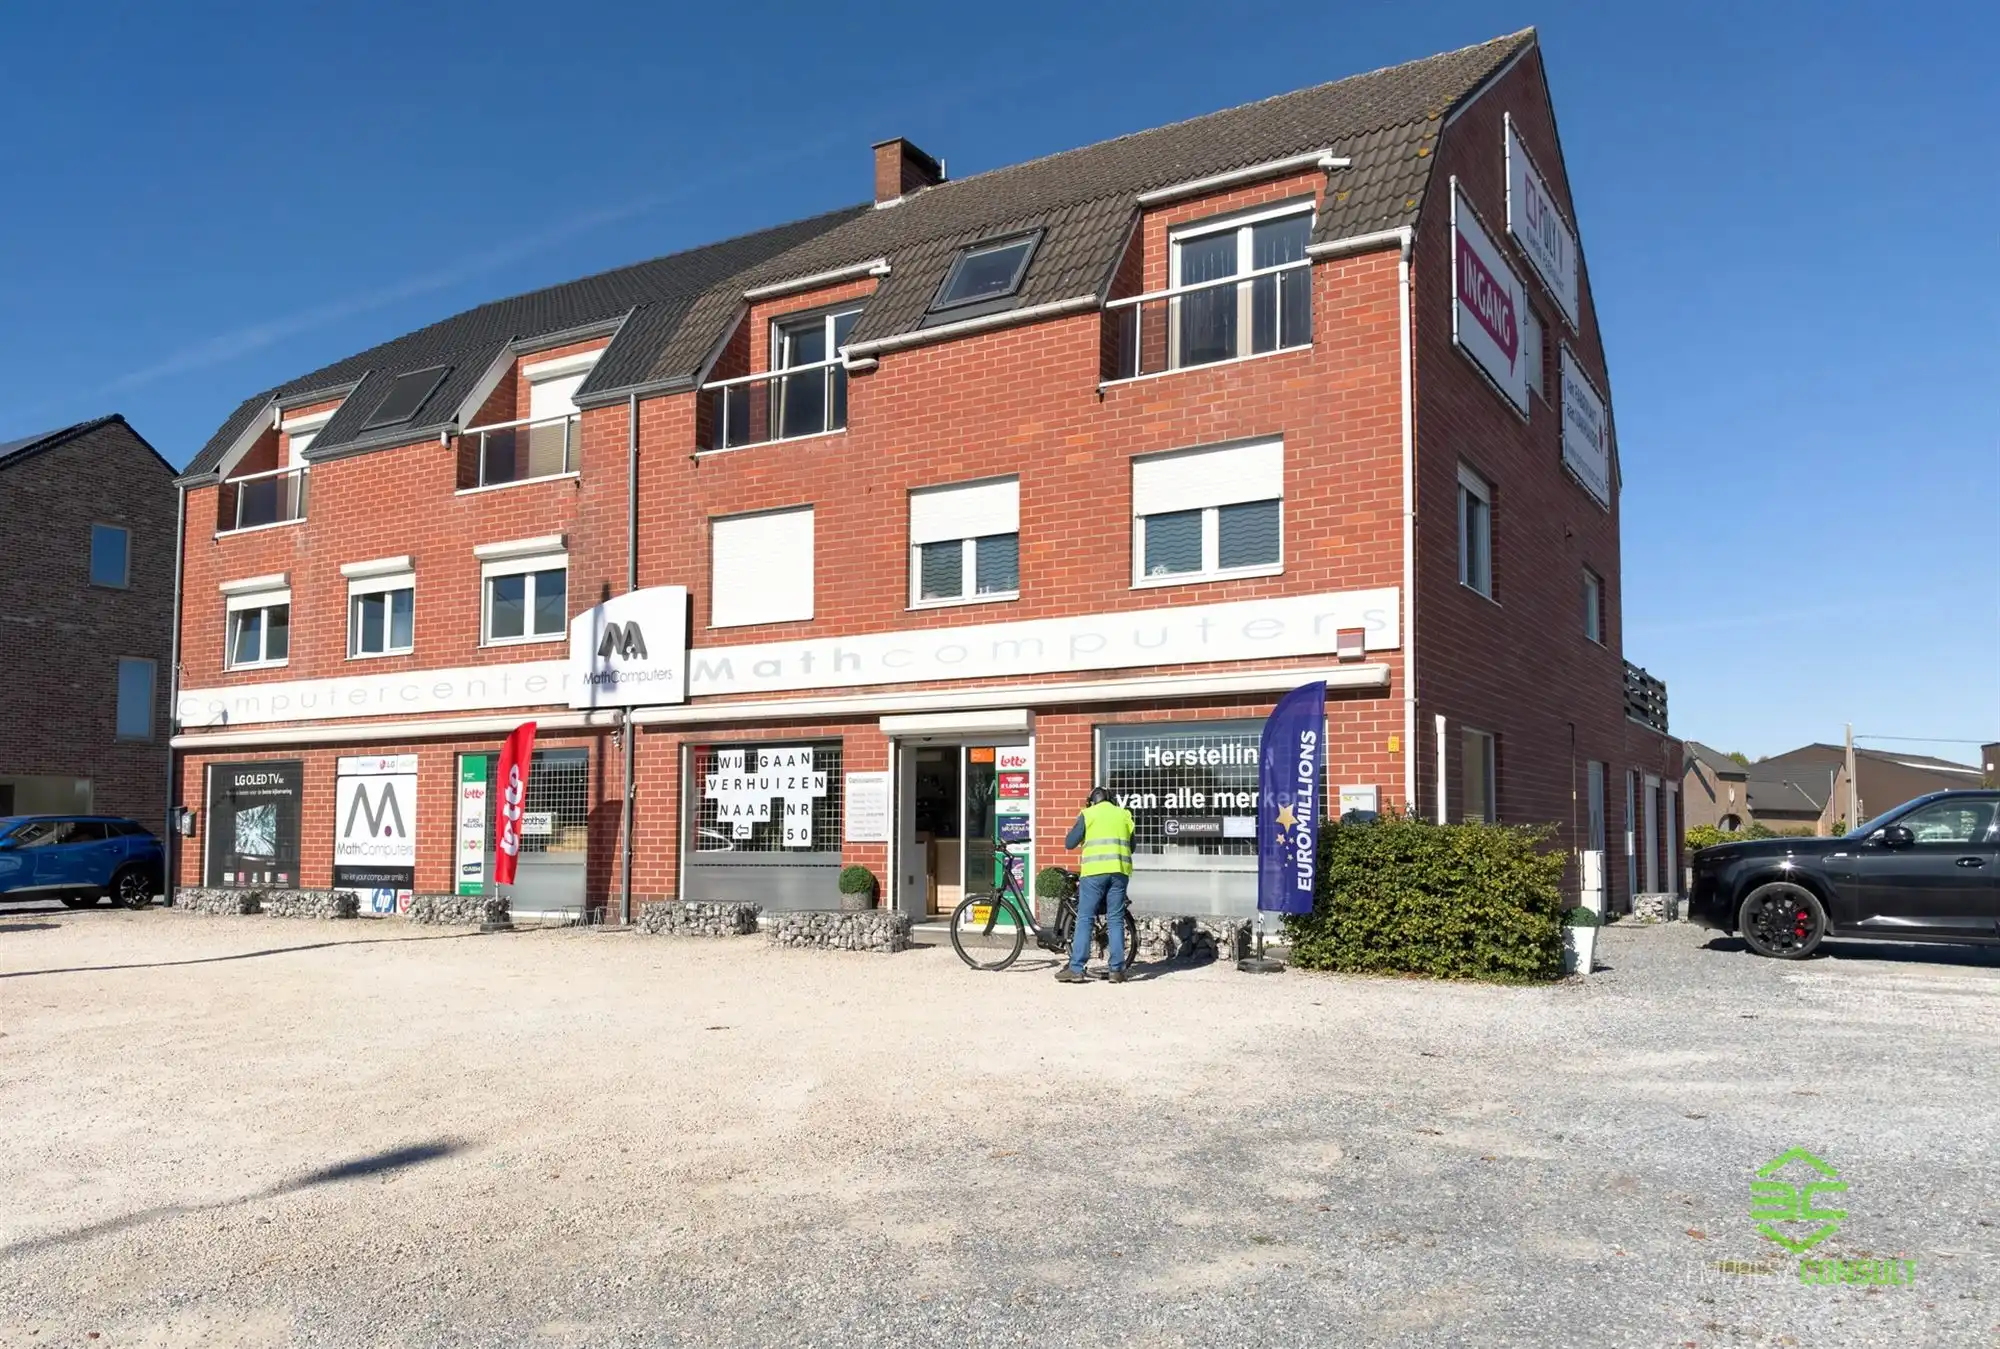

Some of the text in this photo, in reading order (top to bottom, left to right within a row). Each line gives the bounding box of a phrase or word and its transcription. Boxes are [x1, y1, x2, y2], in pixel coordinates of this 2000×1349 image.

[1463, 250, 1511, 347] INGANG
[583, 667, 673, 685] MathComputers
[719, 752, 811, 769] WIJ GAAN
[1144, 743, 1274, 768] Herstellin
[235, 774, 246, 786] LG
[246, 773, 268, 786] OLED
[268, 773, 280, 785] TV
[708, 776, 824, 791] VERHUIZEN
[1115, 793, 1157, 809] van
[1164, 787, 1206, 809] alle
[719, 803, 809, 816] NAAR NR
[1297, 730, 1317, 892] EUROMILLIONS
[787, 828, 808, 841] 50
[336, 842, 413, 859] MathComputers
[375, 888, 392, 913] hp
